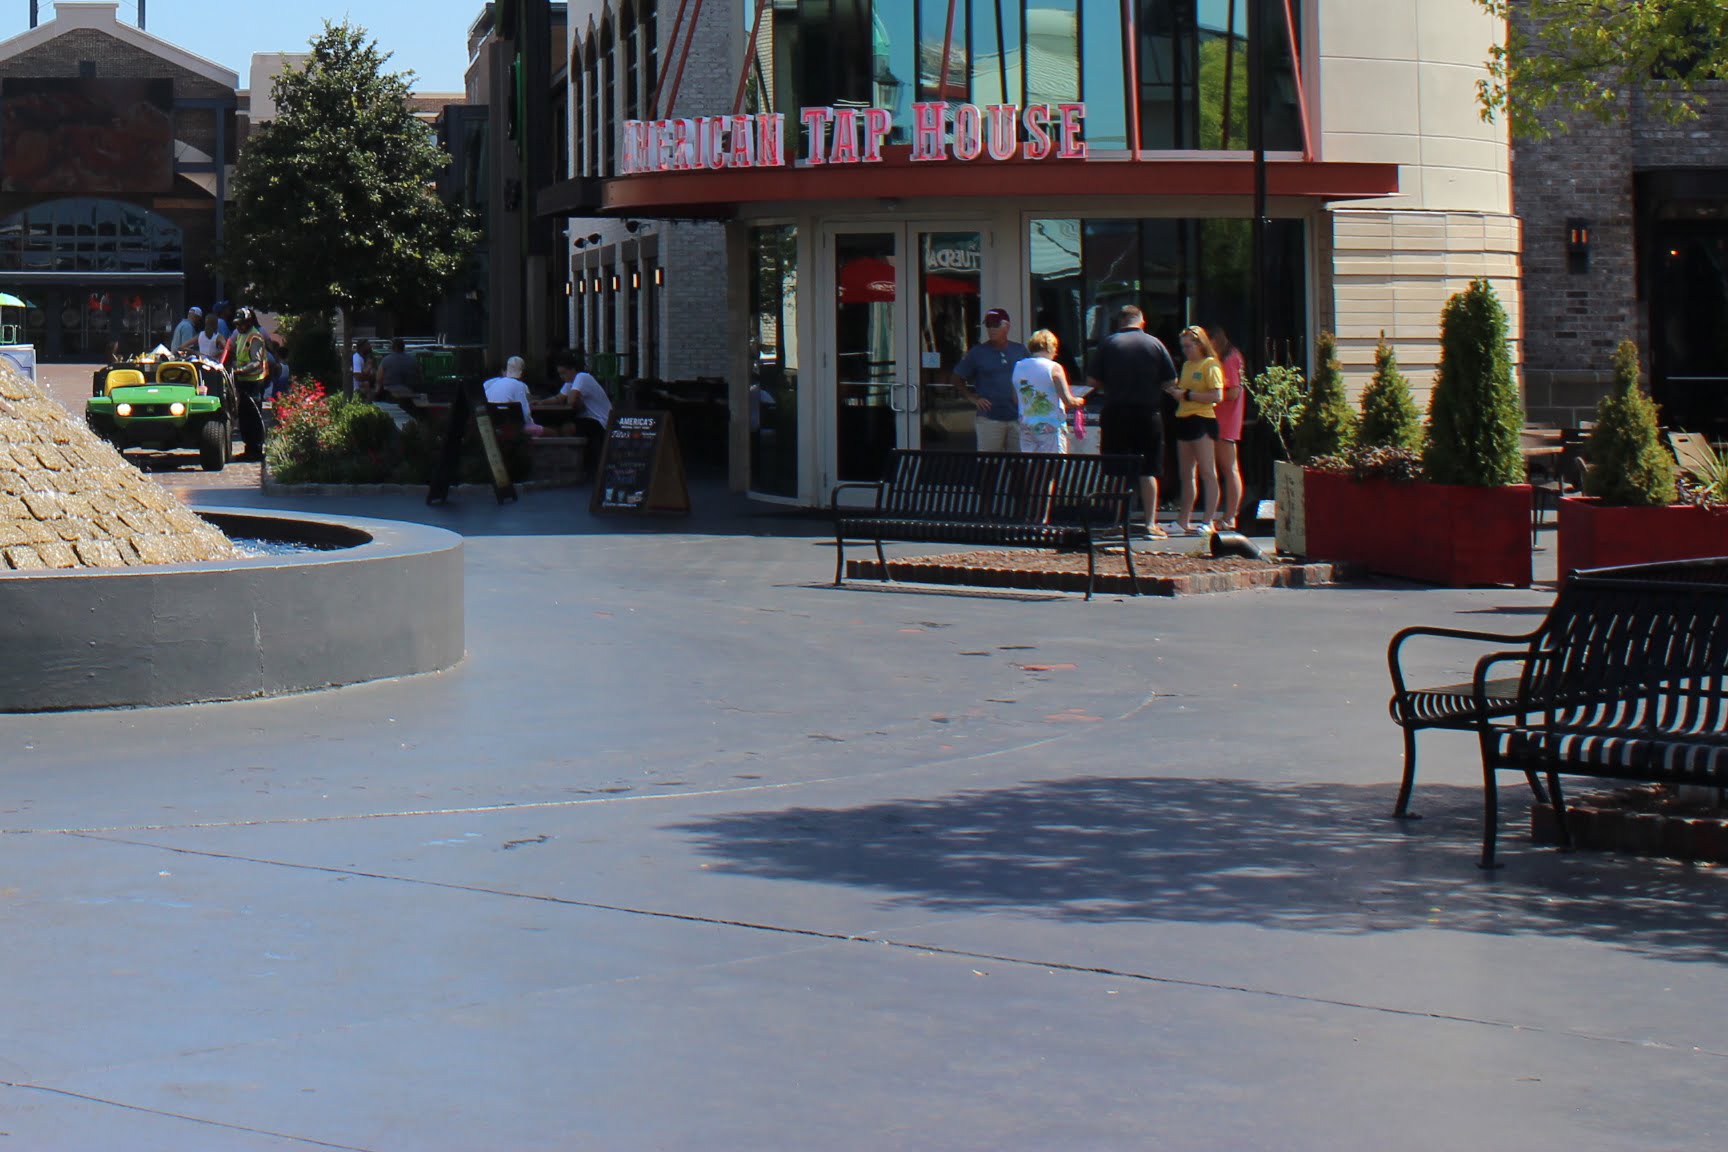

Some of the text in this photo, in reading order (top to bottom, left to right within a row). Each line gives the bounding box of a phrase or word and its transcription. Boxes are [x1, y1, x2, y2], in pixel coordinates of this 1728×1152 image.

[622, 101, 1090, 175] AMERICAN TAP HOUSE
